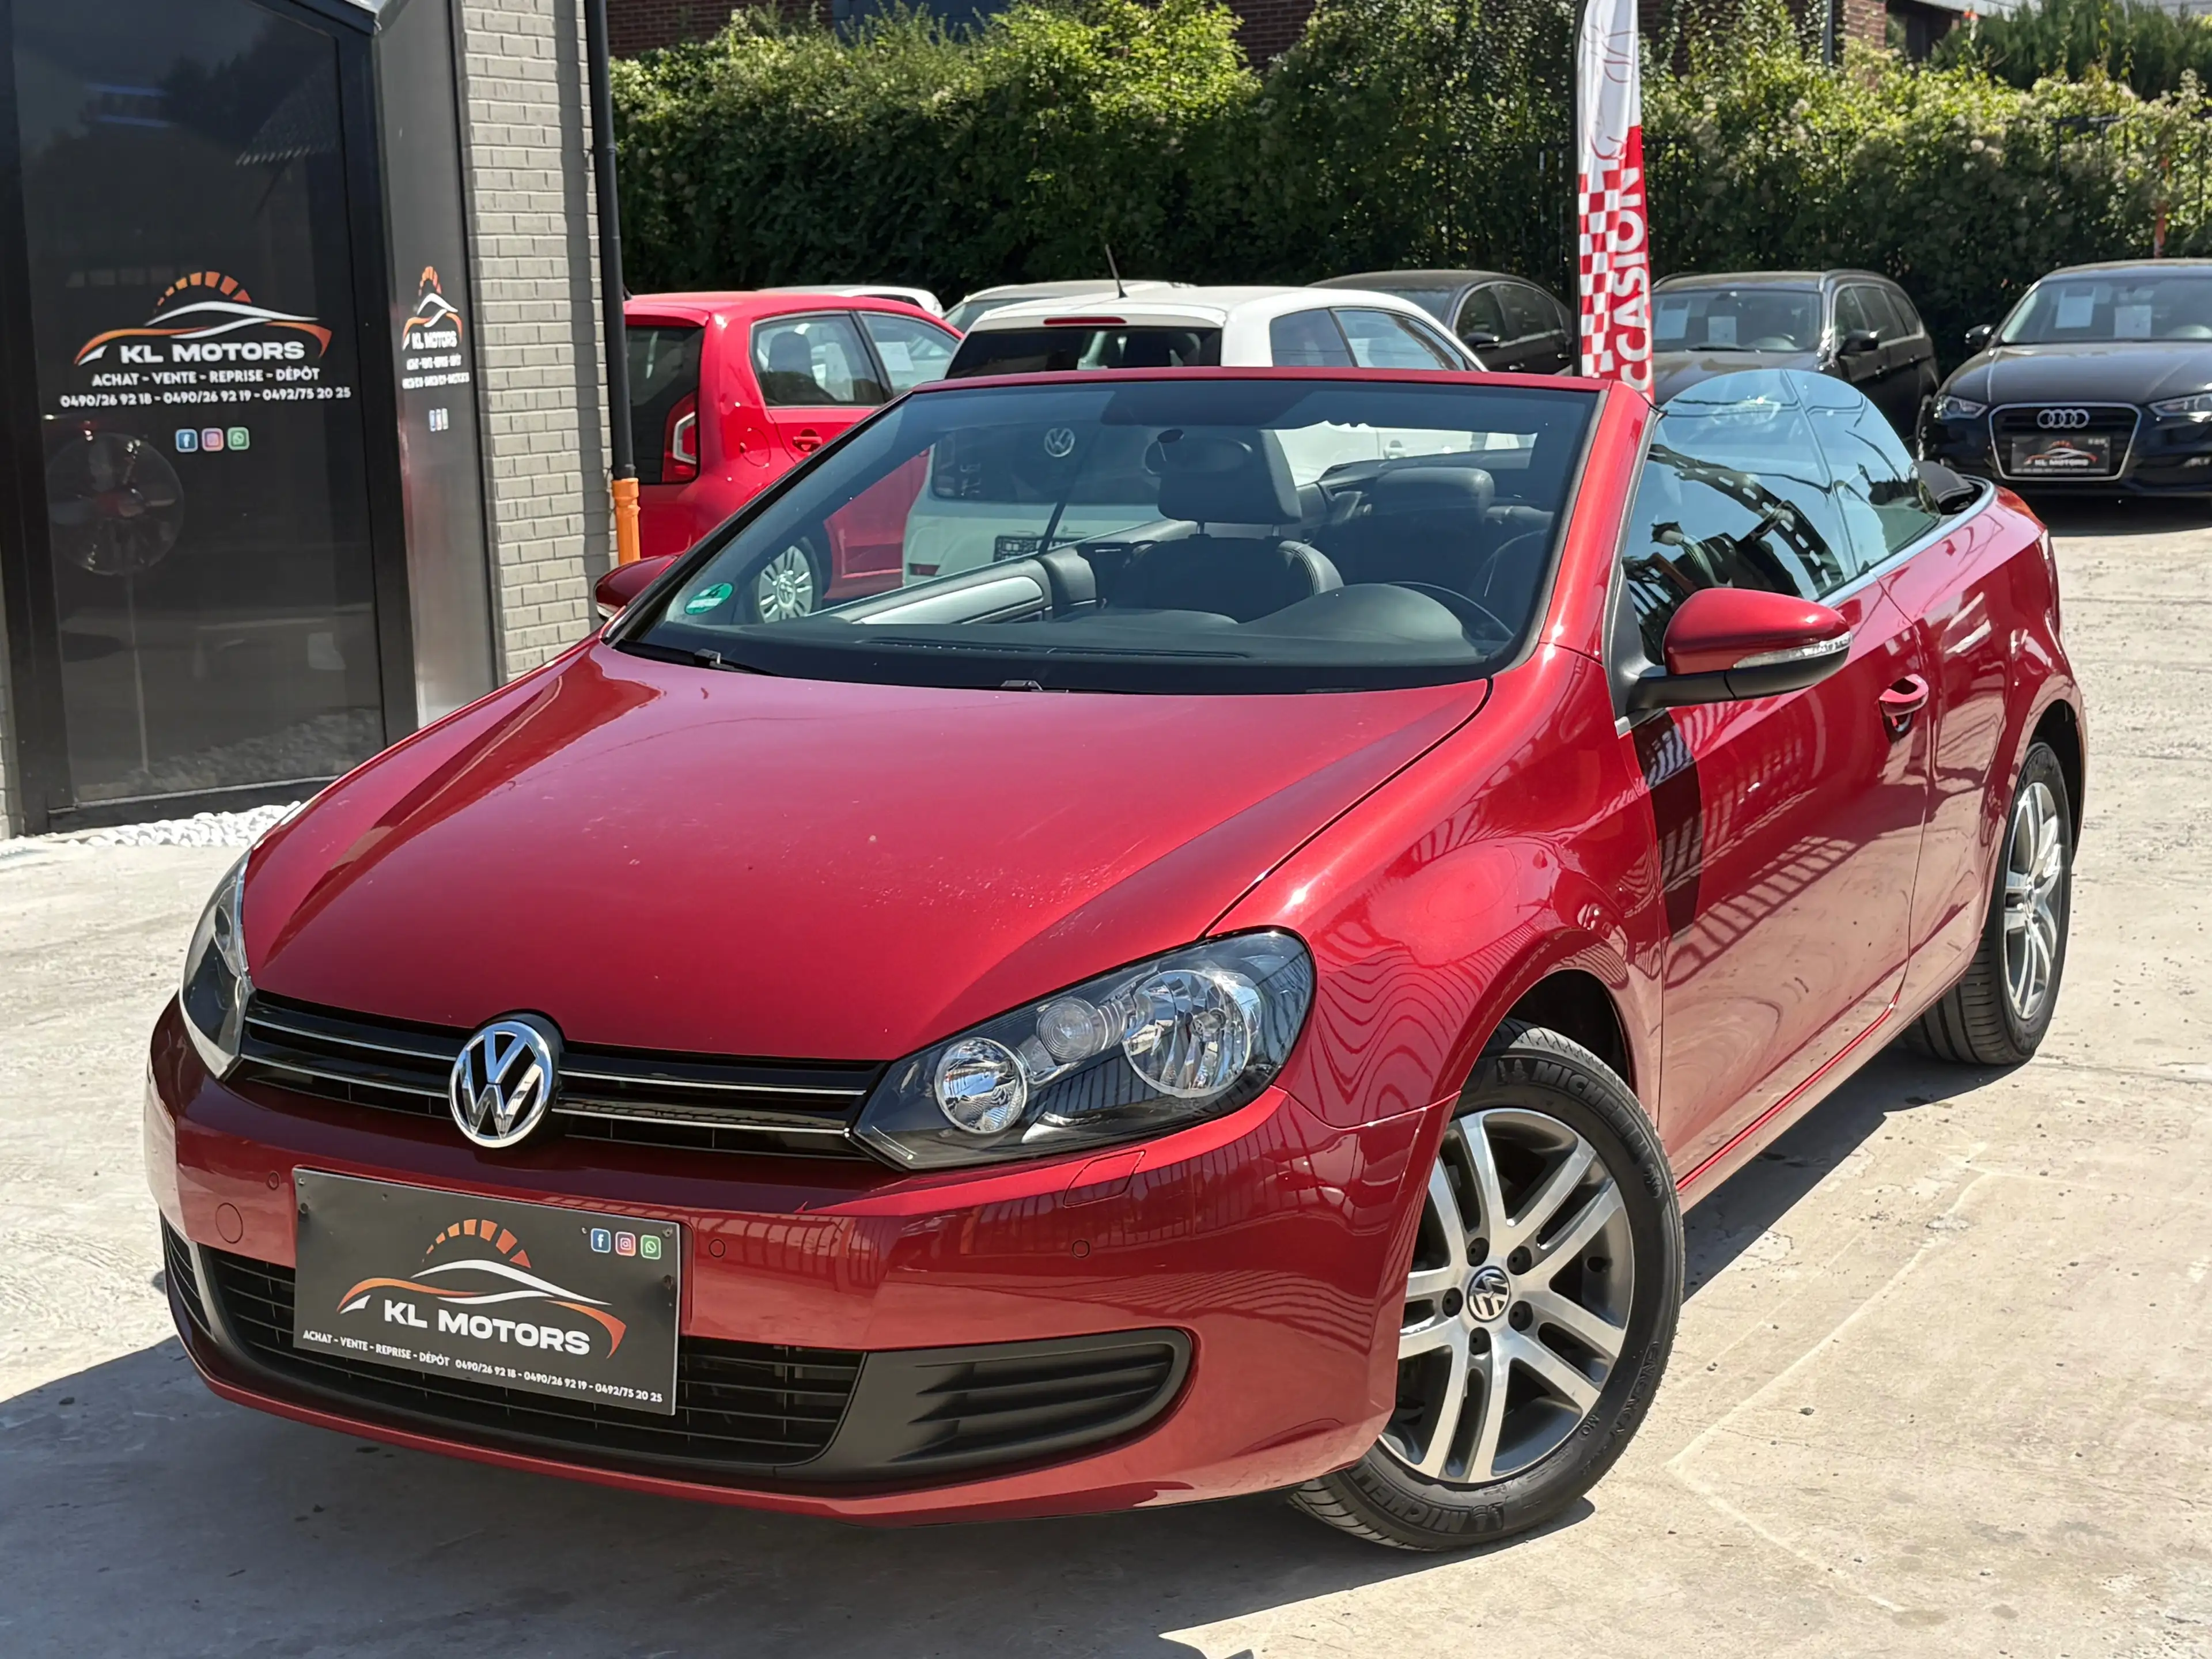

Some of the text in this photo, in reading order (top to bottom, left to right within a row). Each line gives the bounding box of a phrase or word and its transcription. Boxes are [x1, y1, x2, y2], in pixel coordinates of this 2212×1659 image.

[1613, 167, 1652, 404] CCASION
[92, 373, 139, 387] ACHAT
[151, 371, 197, 385] VENTE
[209, 369, 264, 383] REPRISE
[275, 365, 320, 381] DÉPÔT
[120, 341, 305, 363] KL MOTORS
[59, 393, 118, 408] 0490/26
[119, 393, 137, 406] 92
[162, 391, 219, 404] 0490/26
[220, 390, 237, 402] 92
[239, 389, 252, 402] 19
[262, 388, 315, 402] 0492/75
[317, 387, 334, 399] 20
[336, 387, 351, 399] 25
[449, 1021, 552, 1147] VW
[1531, 1060, 1651, 1161] MICHELIN
[384, 1299, 590, 1355] KL MOTORS
[303, 1330, 332, 1344] ACHAT
[340, 1336, 368, 1351] VENTE
[376, 1343, 411, 1359] REPRISE
[419, 1351, 450, 1366] DÉPÔT
[455, 1359, 493, 1374] 0490/26
[494, 1366, 506, 1377] 92
[524, 1371, 563, 1387] 0490/26
[565, 1378, 576, 1389] 92
[578, 1380, 587, 1390] 19
[595, 1383, 634, 1398] 0492/75
[635, 1390, 649, 1400] 20
[650, 1392, 663, 1403] 25
[1350, 1463, 1468, 1533] MICHELI
